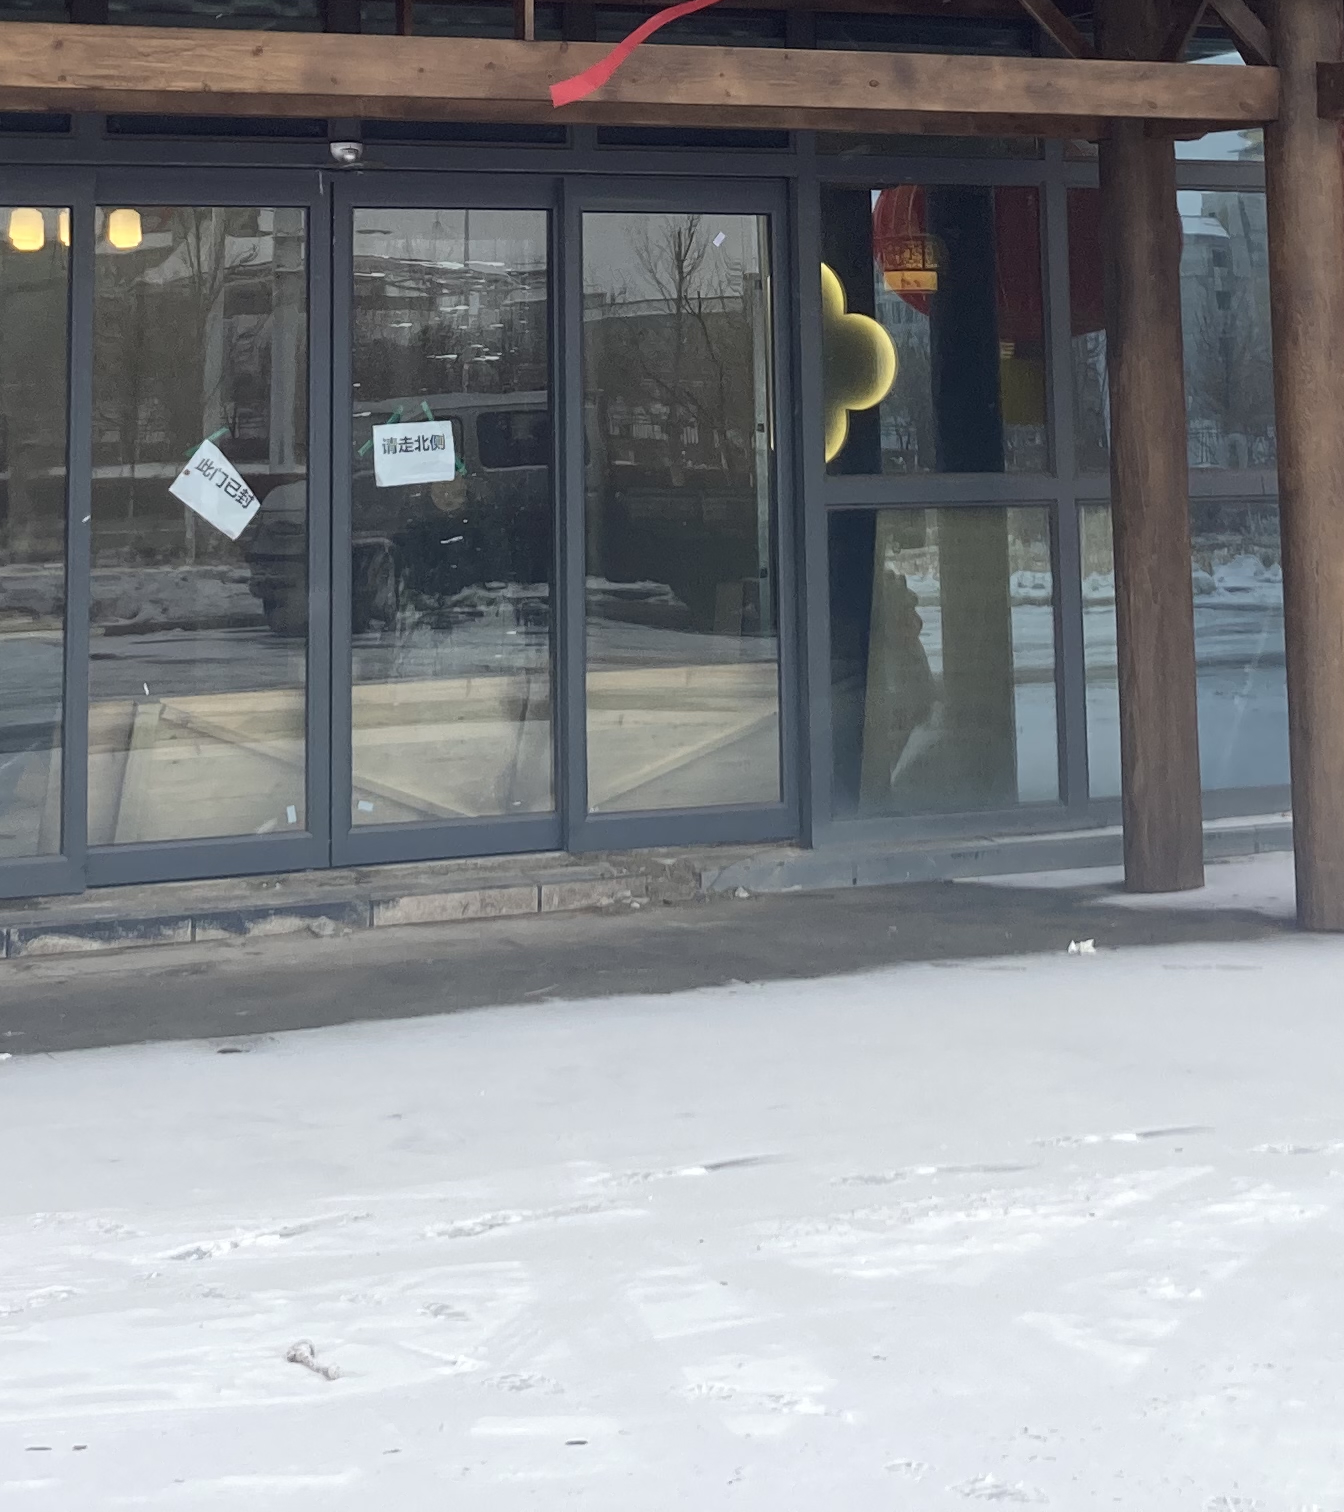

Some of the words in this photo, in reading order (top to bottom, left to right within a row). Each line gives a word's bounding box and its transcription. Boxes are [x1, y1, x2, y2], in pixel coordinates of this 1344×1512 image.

[382, 434, 446, 455] 请走北侧
[195, 458, 255, 509] 此门已封
